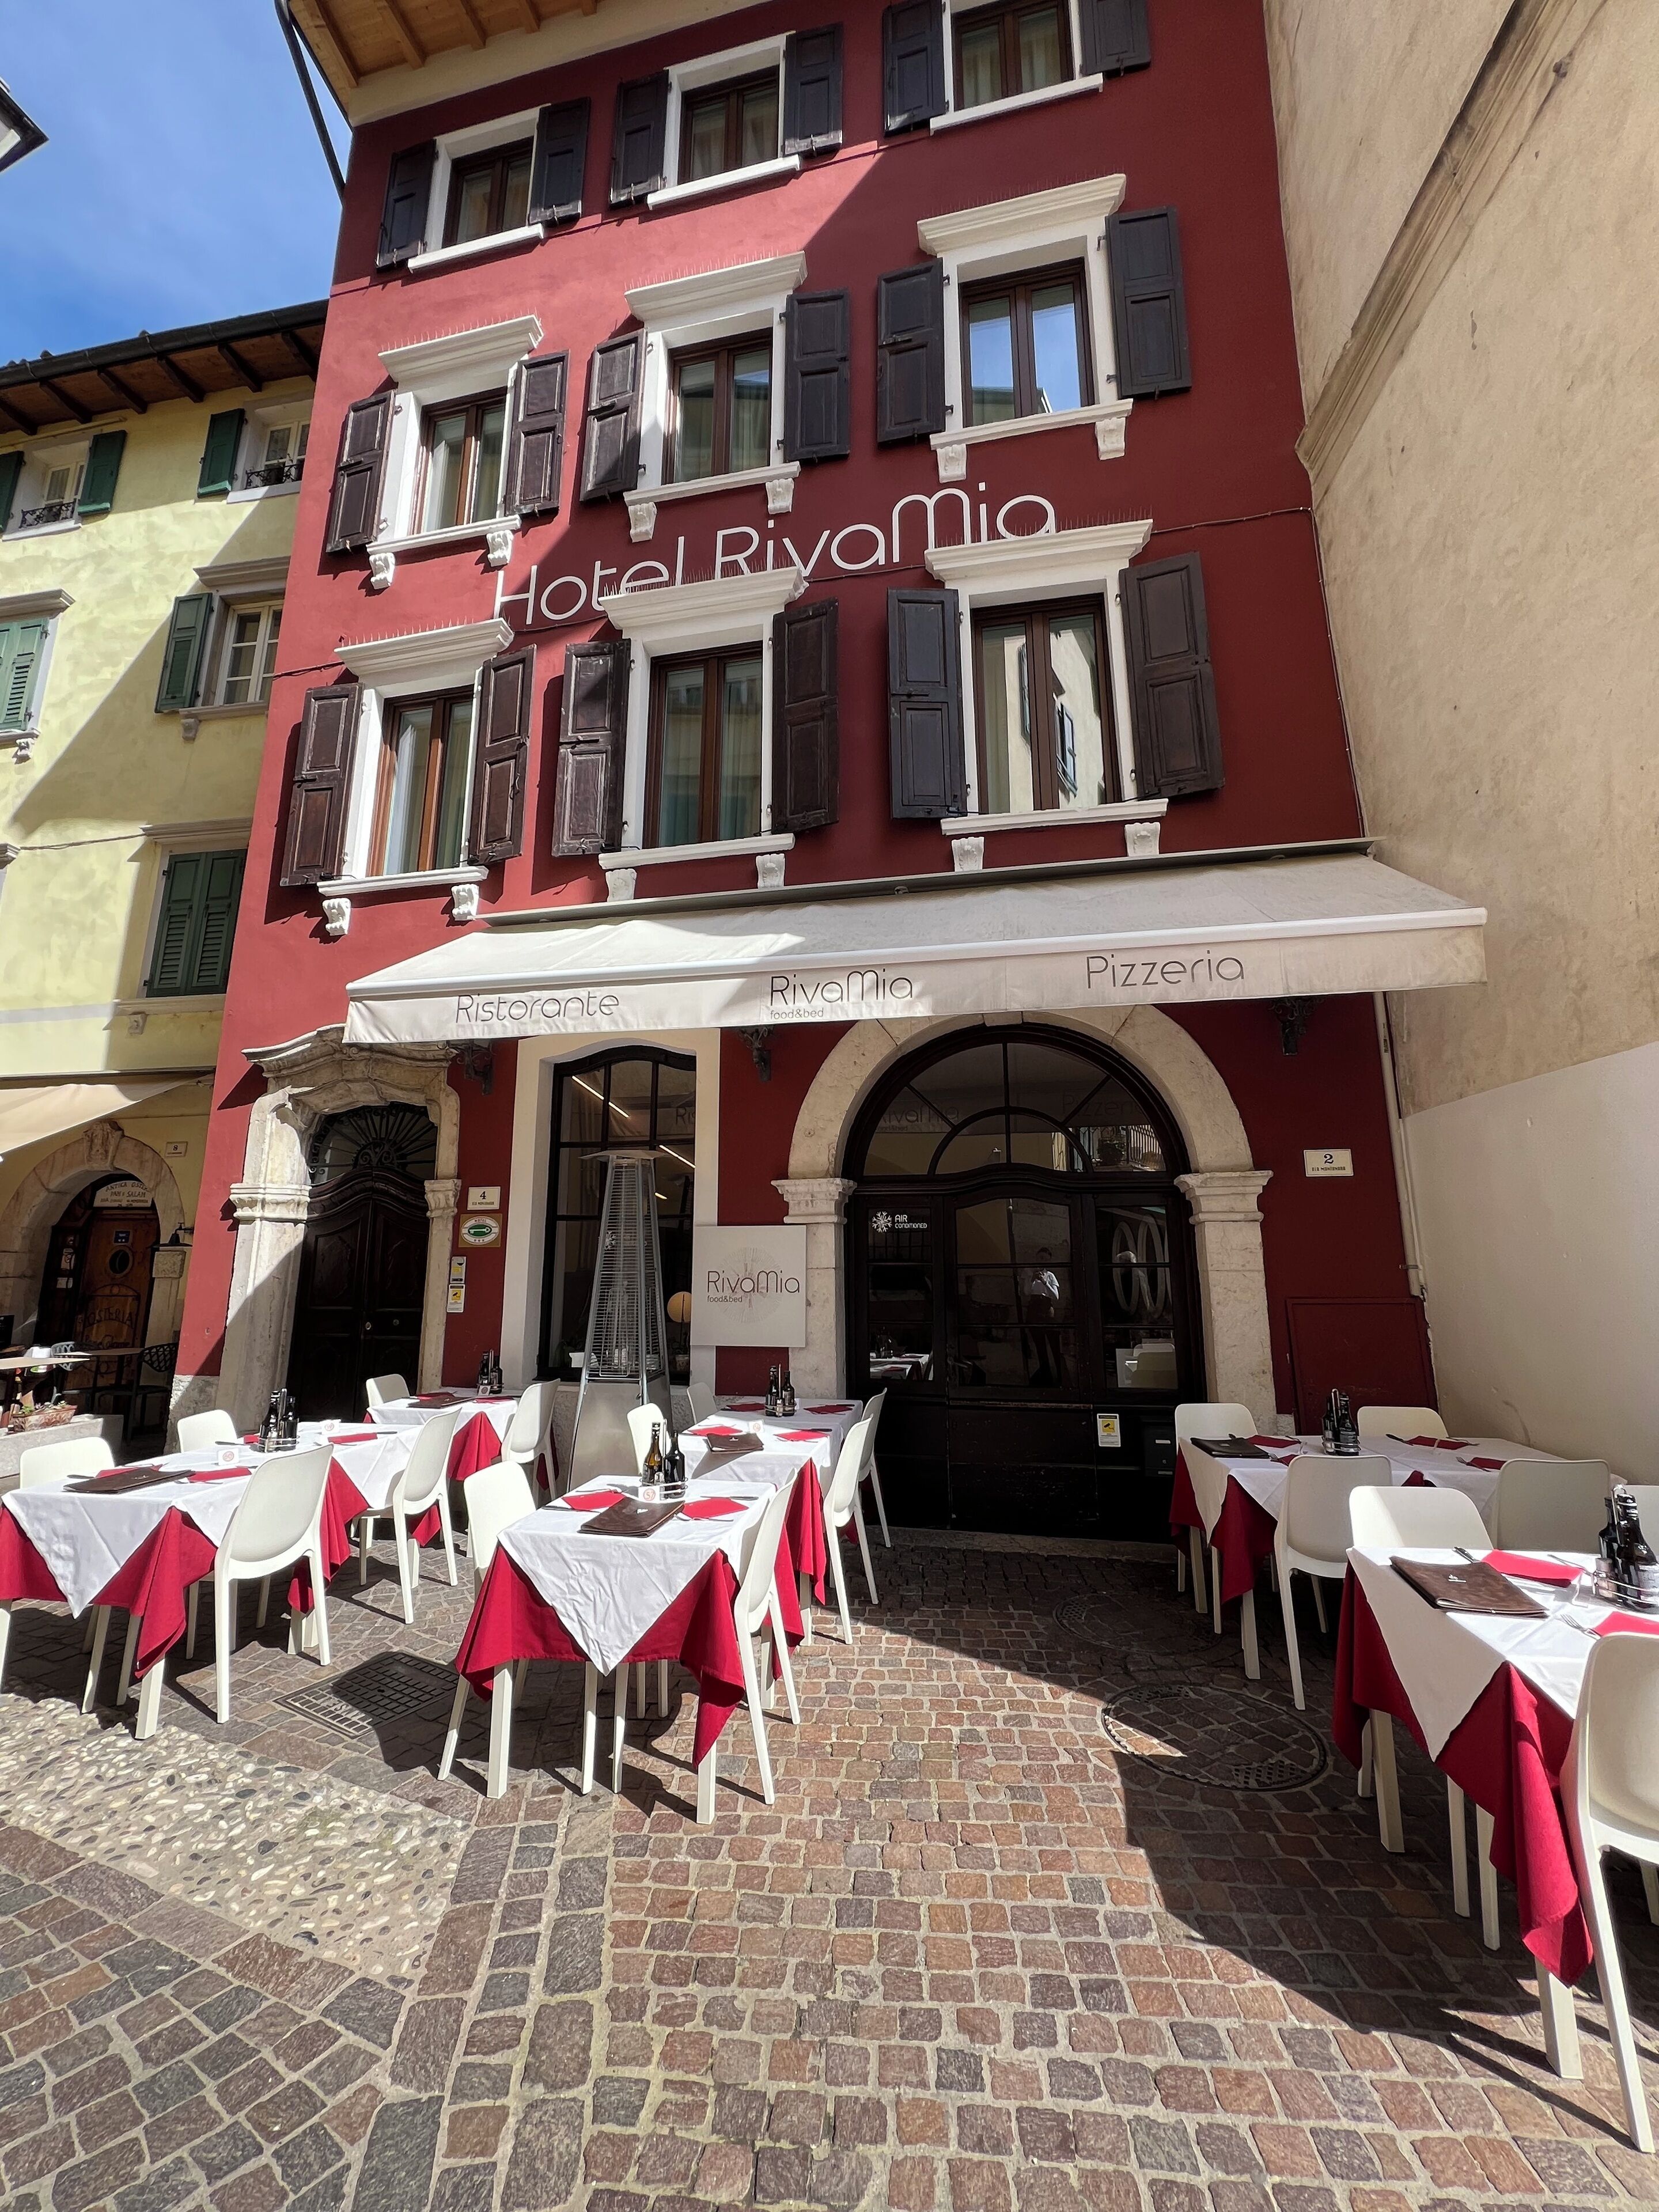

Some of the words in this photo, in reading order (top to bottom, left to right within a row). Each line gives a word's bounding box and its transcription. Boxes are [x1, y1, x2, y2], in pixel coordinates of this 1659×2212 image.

[494, 536, 684, 625] Hotel
[714, 482, 1055, 580] RivaMia
[1086, 950, 1244, 988] Pizzeria
[770, 968, 912, 1006] RivaMia
[456, 991, 619, 1023] Ristorante
[770, 1007, 824, 1020] food&bed
[1324, 1154, 1334, 1164] 2
[105, 1181, 127, 1192] ANTICA
[131, 1181, 147, 1191] OSTE
[479, 1191, 486, 1200] 4
[895, 1214, 908, 1222] AIR
[707, 1270, 800, 1293] RivaMia
[645, 1491, 654, 1499] 57
